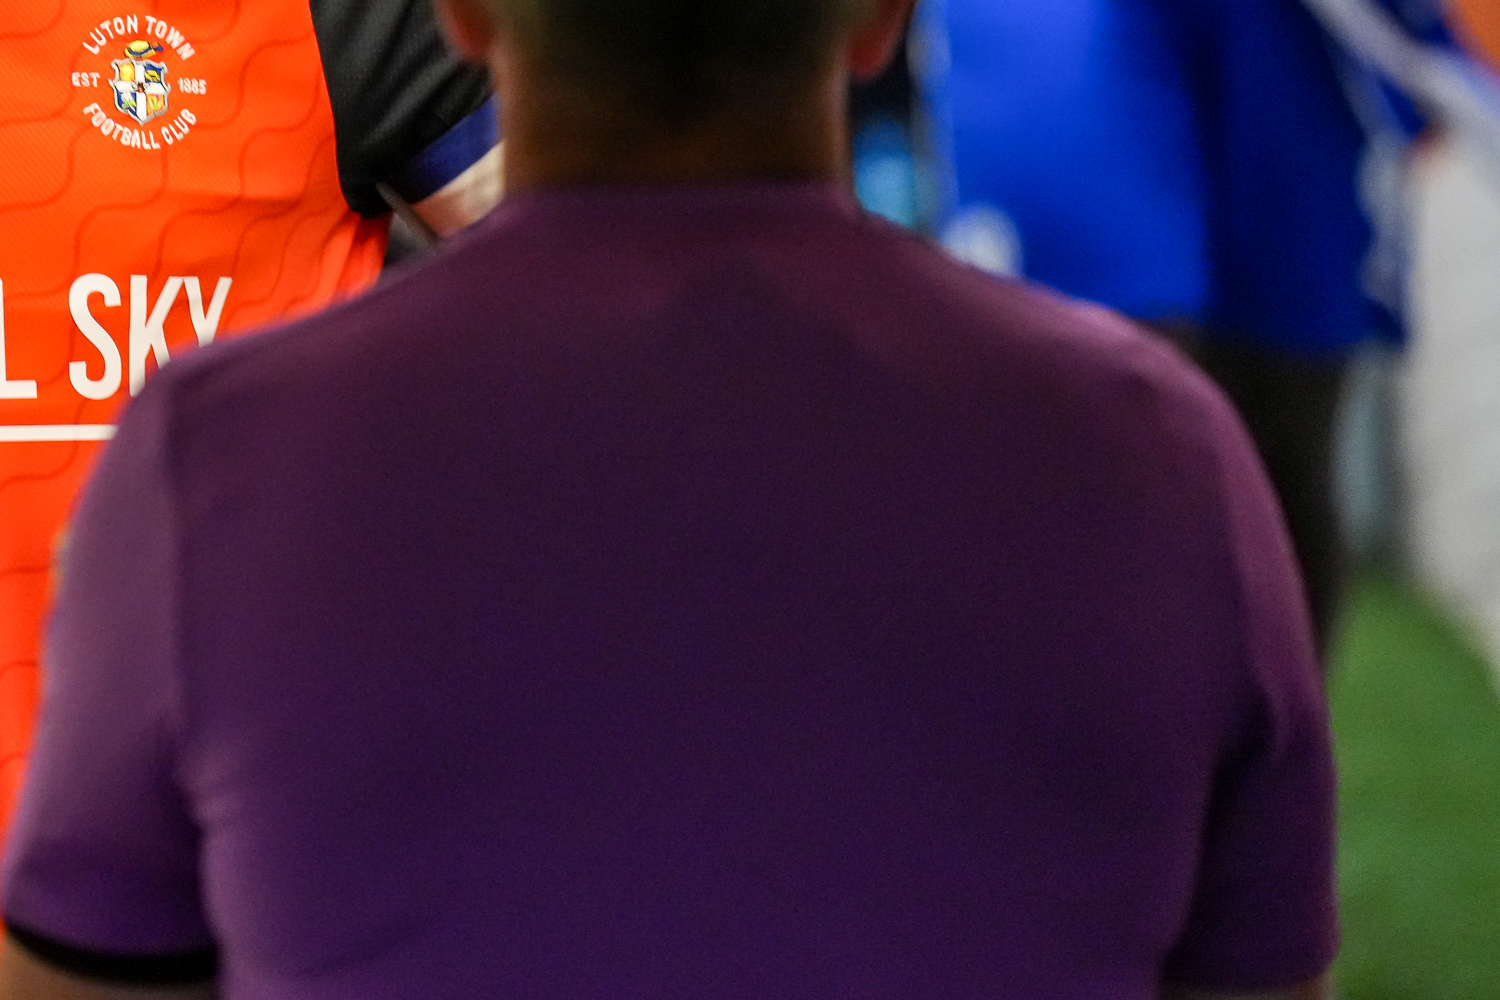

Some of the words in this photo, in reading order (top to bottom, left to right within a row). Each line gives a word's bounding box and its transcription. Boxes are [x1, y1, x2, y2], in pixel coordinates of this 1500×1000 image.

[82, 13, 139, 55] LUTON
[144, 15, 196, 61] TOWN
[71, 72, 101, 88] EST
[177, 77, 207, 95] 1885
[82, 102, 161, 150] FOOTBALL
[160, 108, 197, 145] CLUB
[67, 272, 234, 401] SKY
